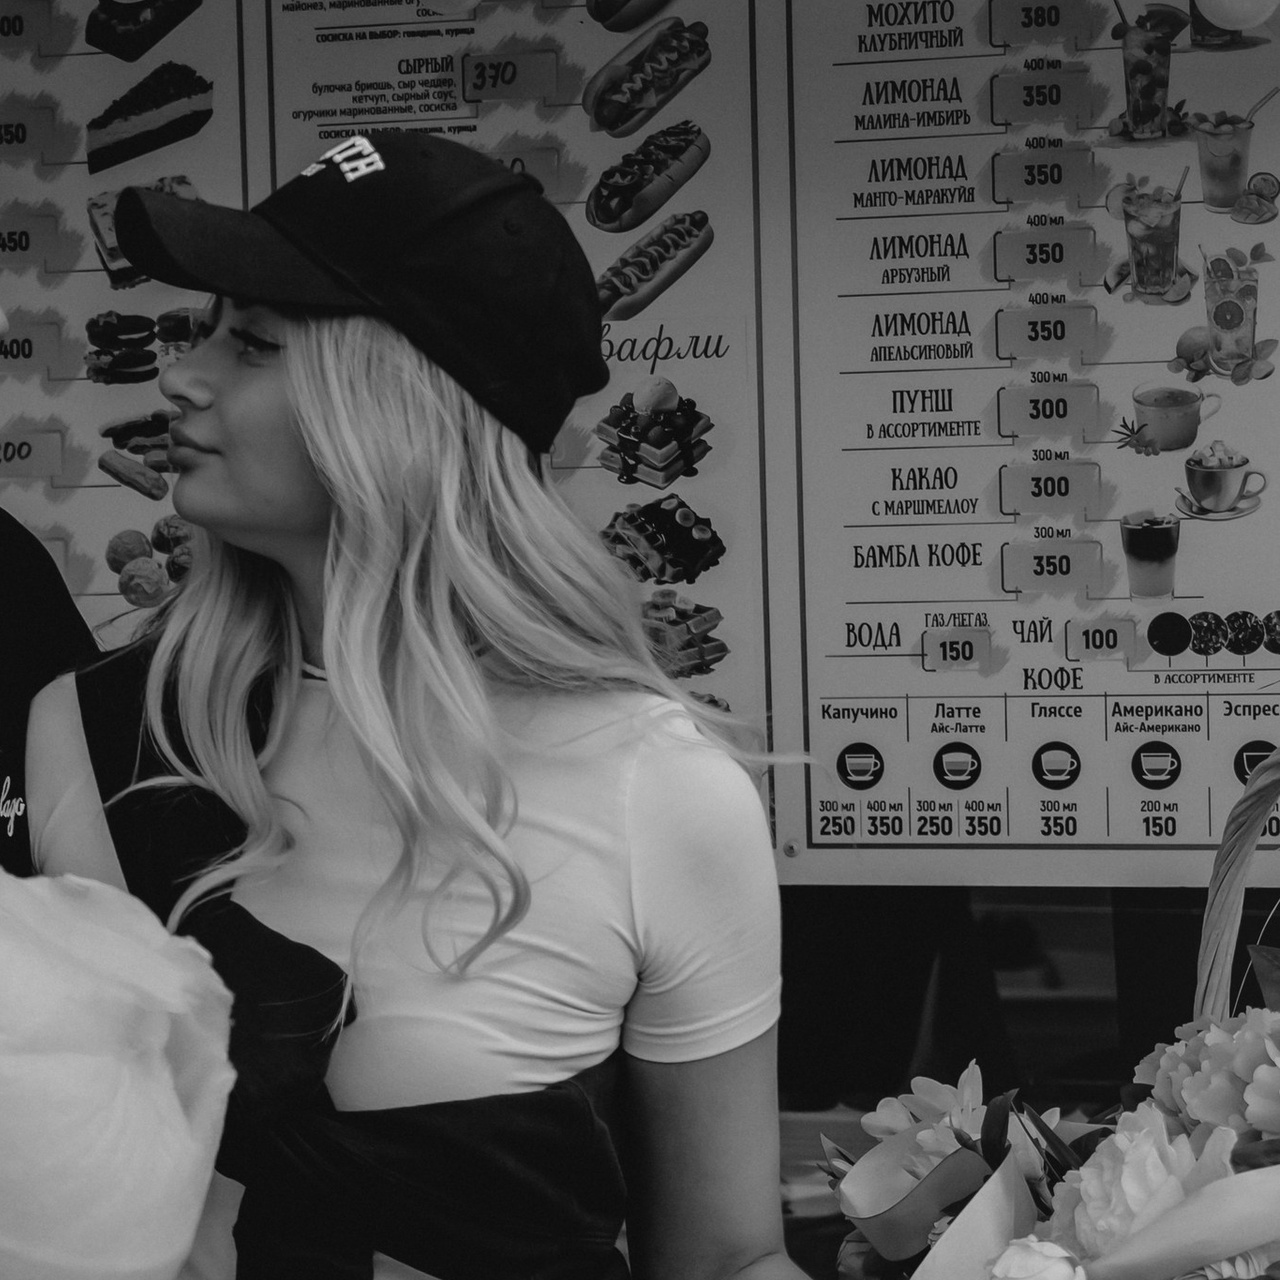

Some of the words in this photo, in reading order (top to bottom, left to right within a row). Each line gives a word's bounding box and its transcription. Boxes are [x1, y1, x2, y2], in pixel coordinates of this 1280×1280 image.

[282, 0, 326, 12] майонез,
[866, 0, 954, 27] МОХИТО
[1021, 5, 1060, 28] 380
[316, 33, 354, 43] СОСИСКА
[355, 31, 368, 41] НА
[369, 30, 401, 41] ВЫБОР:
[858, 27, 964, 53] КЛУБНИЧНЫЙ
[397, 55, 454, 74] СЫРНЫЙ
[1023, 60, 1045, 71] 400
[1047, 61, 1062, 71] мл
[472, 61, 517, 90] 370
[312, 82, 352, 96] булочка
[355, 80, 395, 93] бриошь,
[397, 81, 416, 91] сыр
[418, 78, 457, 88] чеддер,
[352, 94, 389, 104] кетчуп,
[392, 90, 430, 103] сырный
[432, 91, 457, 101] соус,
[862, 77, 962, 105] ЛИМОНАД
[1022, 84, 1061, 106] 350
[292, 108, 337, 121] огурчики
[340, 105, 416, 119] маринованные,
[419, 102, 457, 113] сосиска
[854, 109, 971, 130] МАЛИНА-ИМБИРЬ
[1025, 137, 1046, 149] 400
[1048, 138, 1063, 149] мл
[867, 155, 968, 182] ЛИМОНАД
[1024, 163, 1063, 185] 350
[853, 186, 975, 208] МАНГО-МАРАКУЙЯ
[1026, 215, 1047, 226] 400
[1049, 216, 1065, 226] мл
[869, 233, 969, 260] ЛИМОНАД
[1025, 242, 1064, 264] 350
[881, 264, 951, 284] АРБУЗНЫЙ
[1028, 293, 1049, 304] 400
[1051, 294, 1066, 304] мл
[871, 311, 971, 337] ЛИМОНАД
[1027, 320, 1066, 341] 350
[870, 341, 974, 362] АПЕЛЬСИНОВЫЙ
[1030, 371, 1050, 383] 300
[1052, 372, 1068, 383] мл
[891, 388, 953, 413] ПУНШ
[1029, 398, 1068, 419] 300
[866, 423, 874, 439] В
[878, 420, 981, 439] АССОРТИМЕНТЕ
[1032, 449, 1052, 461] 300
[1054, 450, 1070, 461] мл
[891, 466, 958, 491] КАКАО
[1030, 476, 1070, 497] 300
[871, 501, 880, 516] С
[884, 498, 979, 516] МАРШМЕЛЛОУ
[1033, 527, 1054, 538] 300
[1056, 528, 1071, 538] мл
[853, 544, 920, 569] БАМБЛ
[927, 542, 983, 567] КОФЕ
[1033, 555, 1071, 576] 350
[845, 622, 902, 651] ВОДА
[1012, 617, 1053, 643] ЧАЙ
[1082, 629, 1118, 649] 100
[939, 641, 974, 661] 150
[1022, 666, 1083, 690] КОФЕ
[1154, 673, 1160, 684] В
[1164, 673, 1255, 684] АССОРТИМЕНТЕ
[821, 704, 898, 723] Капучино
[934, 703, 981, 719] Латте
[1031, 702, 1083, 718] Гляссе
[1111, 702, 1204, 720] Американо
[1223, 701, 1280, 720] Эспрес
[930, 722, 986, 734] Айс-Латте
[1114, 722, 1201, 735] Айс-Американо
[819, 800, 838, 812] 300
[841, 801, 855, 812] мл
[866, 800, 886, 812] 400
[889, 801, 903, 812] мл
[916, 800, 936, 812] 300
[939, 801, 953, 812] мл
[964, 800, 984, 812] 400
[987, 801, 1001, 812] мл
[1040, 800, 1060, 812] 300
[1062, 801, 1077, 812] мл
[1140, 800, 1160, 812] 200
[1163, 801, 1178, 812] мл
[820, 816, 855, 836] 250
[867, 816, 903, 836] 350
[917, 816, 953, 836] 250
[965, 816, 1001, 836] 350
[1040, 816, 1077, 837] 350
[1142, 816, 1177, 837] 150
